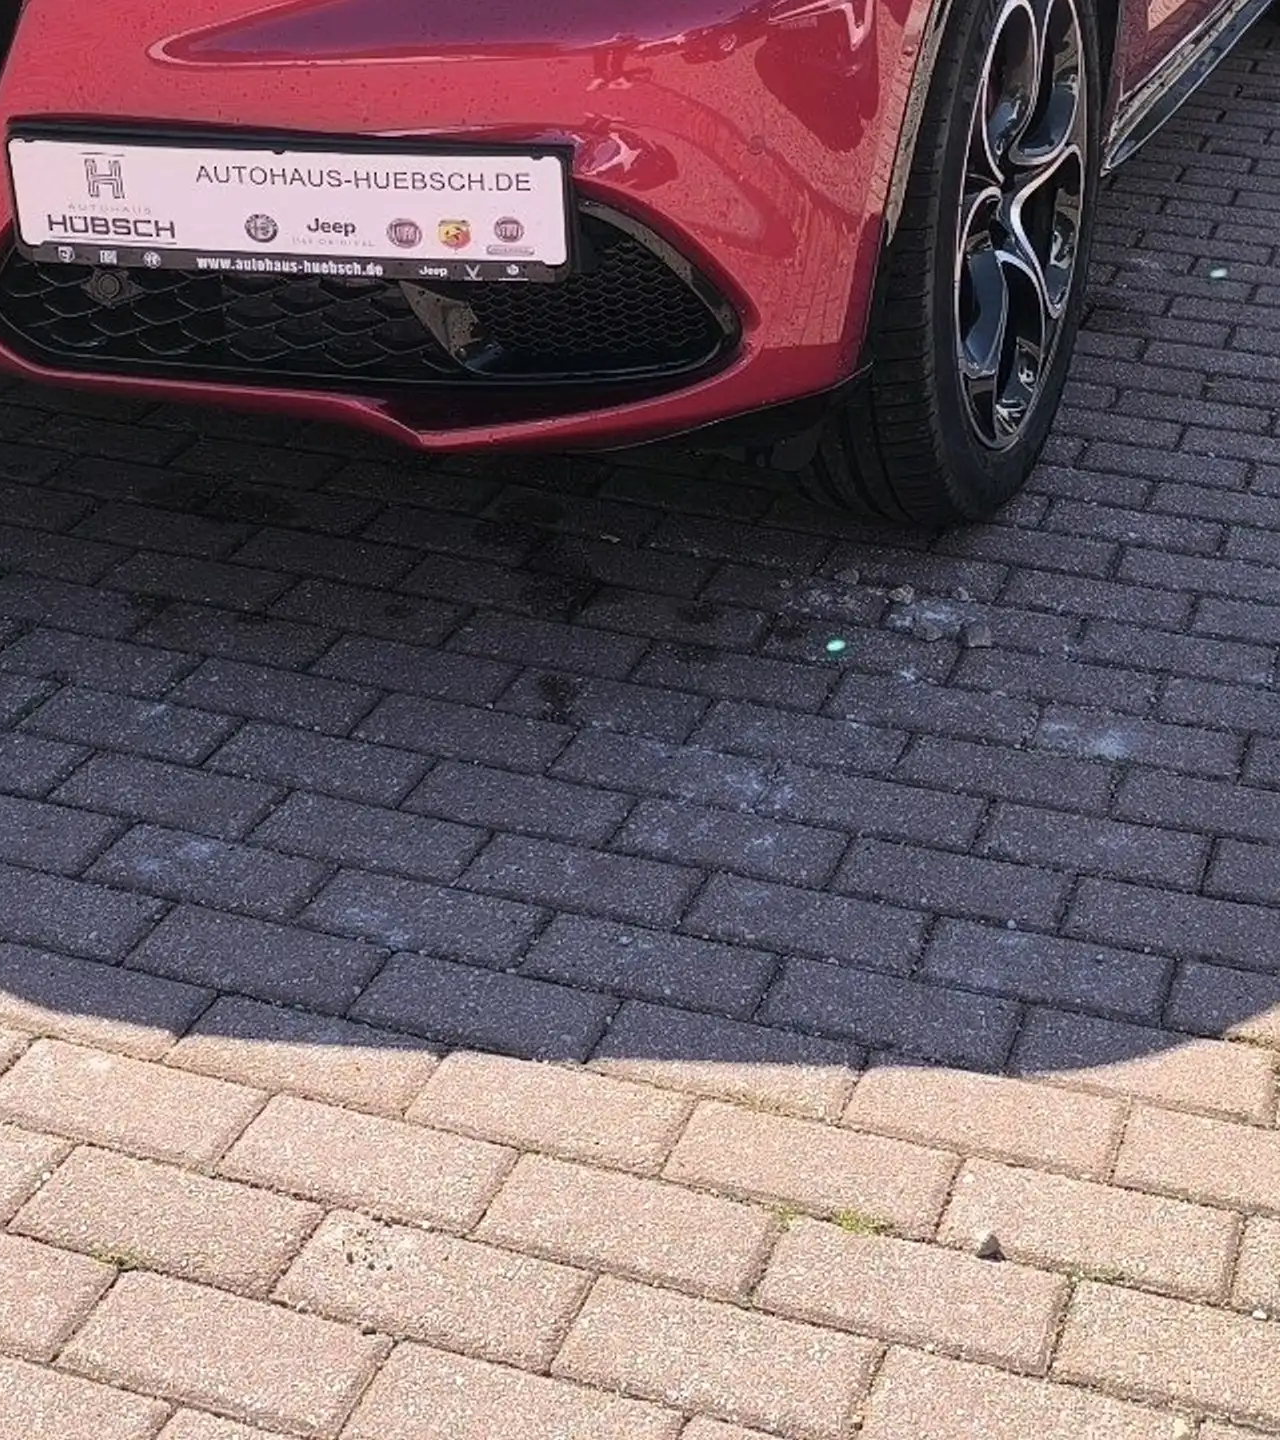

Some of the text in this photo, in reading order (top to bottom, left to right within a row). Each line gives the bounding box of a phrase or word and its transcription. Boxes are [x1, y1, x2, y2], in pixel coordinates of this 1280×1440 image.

[195, 165, 532, 192] AUTOHAUS-HUEBSCH.DE
[47, 213, 357, 240] HÜBSCH Jeep
[196, 256, 384, 277] www.autohaus-huebsch.de
